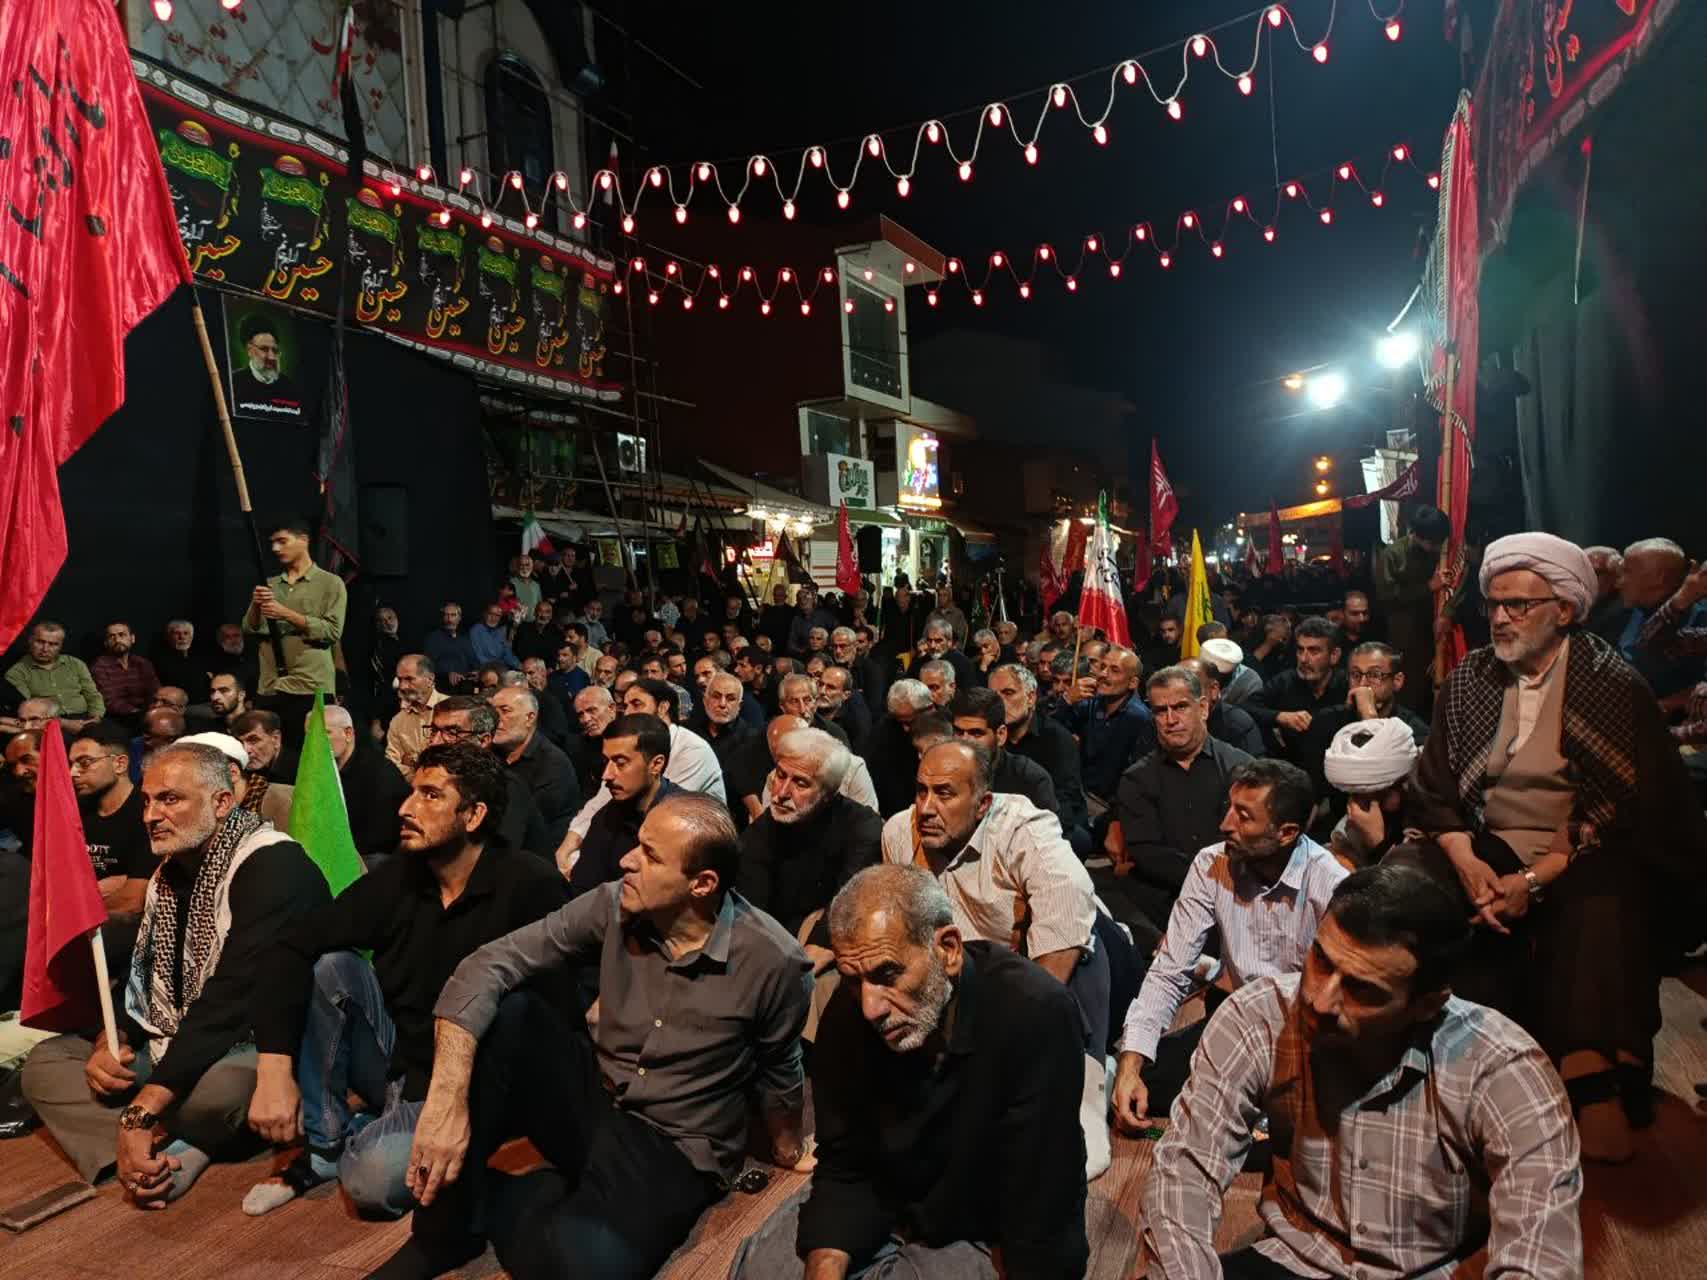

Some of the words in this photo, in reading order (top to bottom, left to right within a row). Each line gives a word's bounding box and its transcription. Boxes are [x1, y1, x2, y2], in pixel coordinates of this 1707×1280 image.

[263, 256, 333, 301] حسین
[356, 281, 408, 322] حسین
[426, 297, 470, 338] حسین
